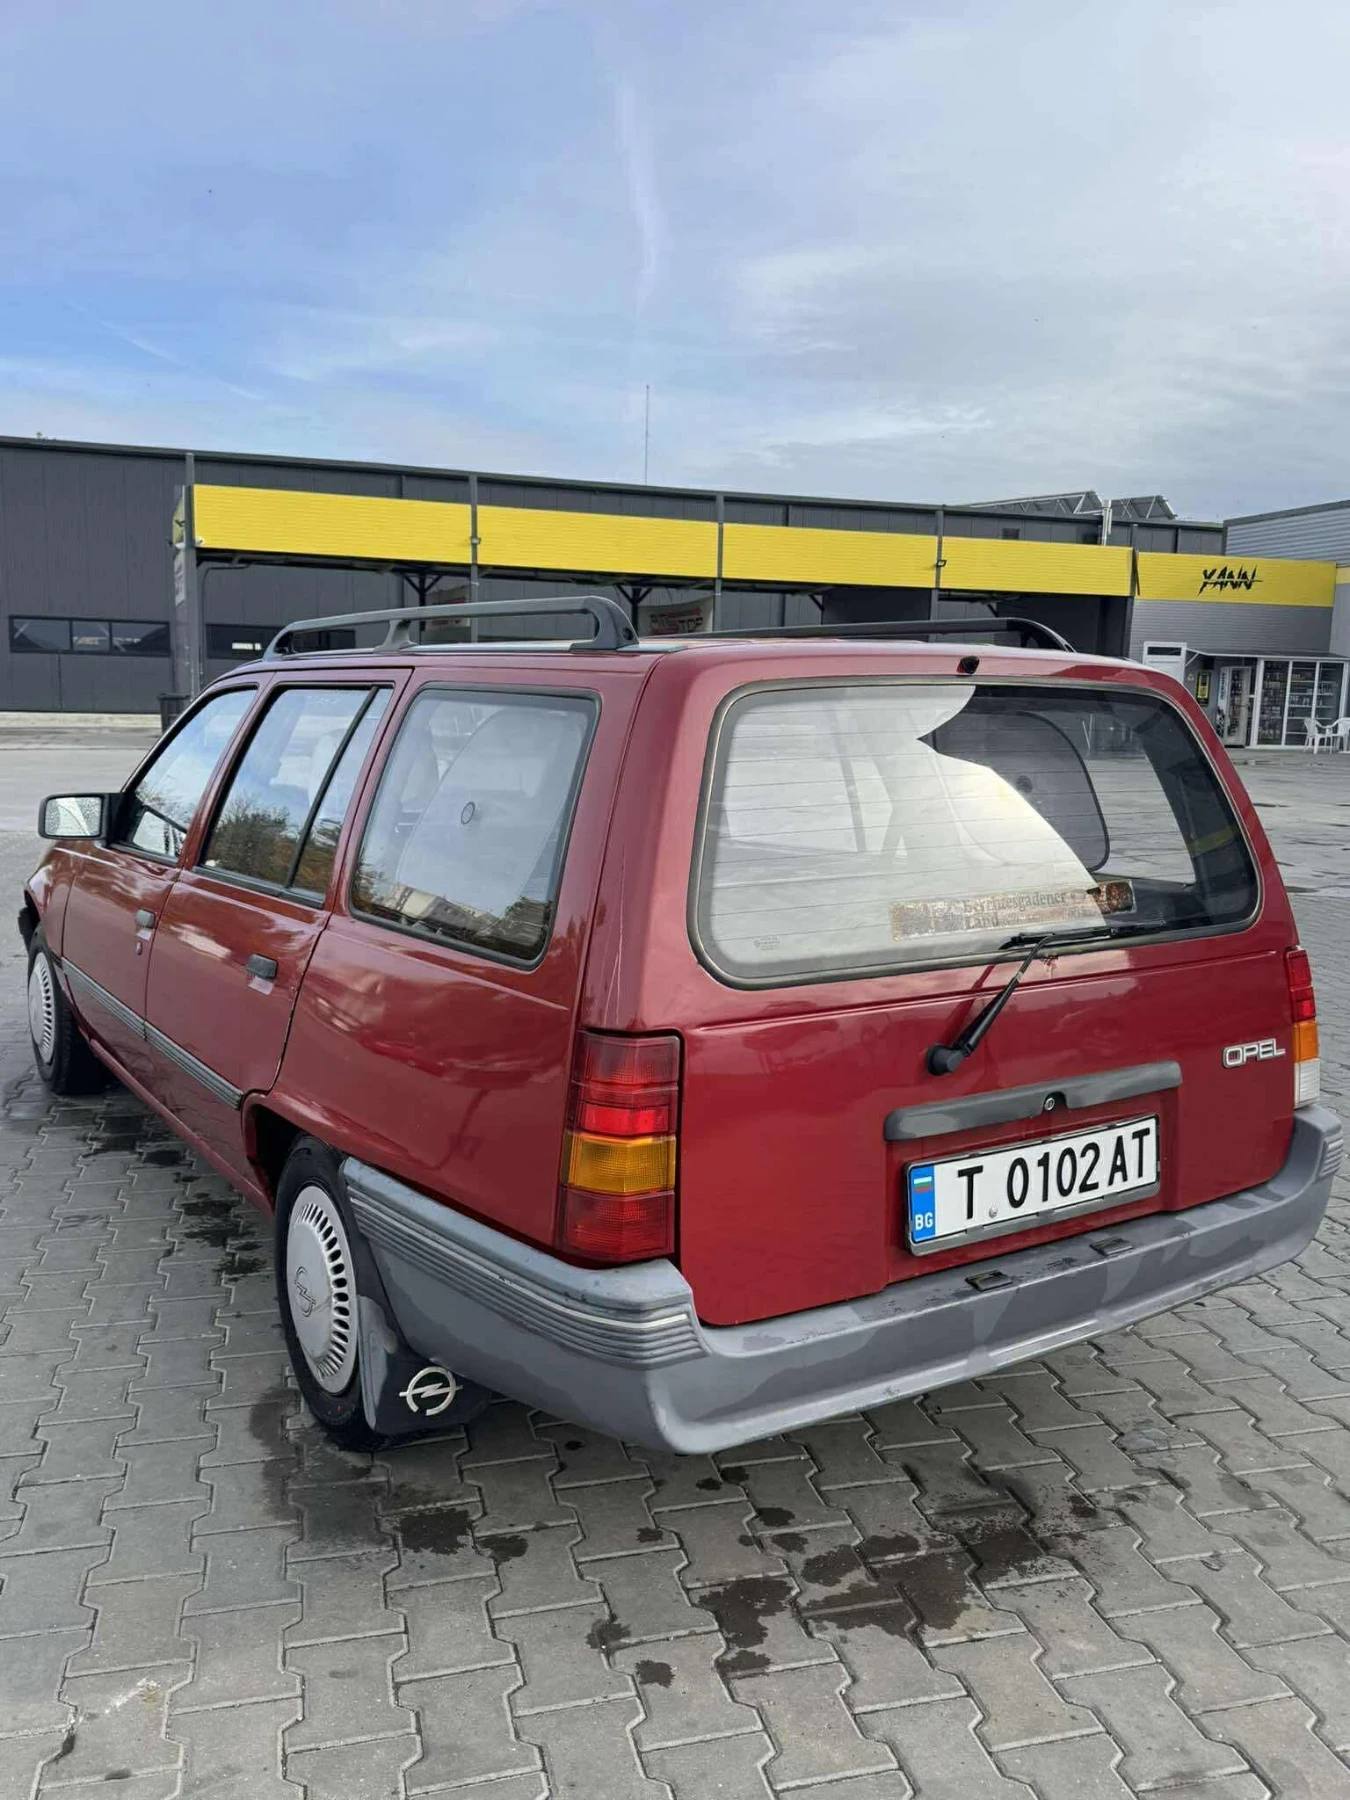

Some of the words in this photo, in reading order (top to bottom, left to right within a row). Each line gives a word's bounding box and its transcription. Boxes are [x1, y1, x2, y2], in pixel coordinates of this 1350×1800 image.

[1223, 1038, 1286, 1067] OPEL
[957, 1165, 984, 1219] T
[915, 1212, 933, 1230] BG
